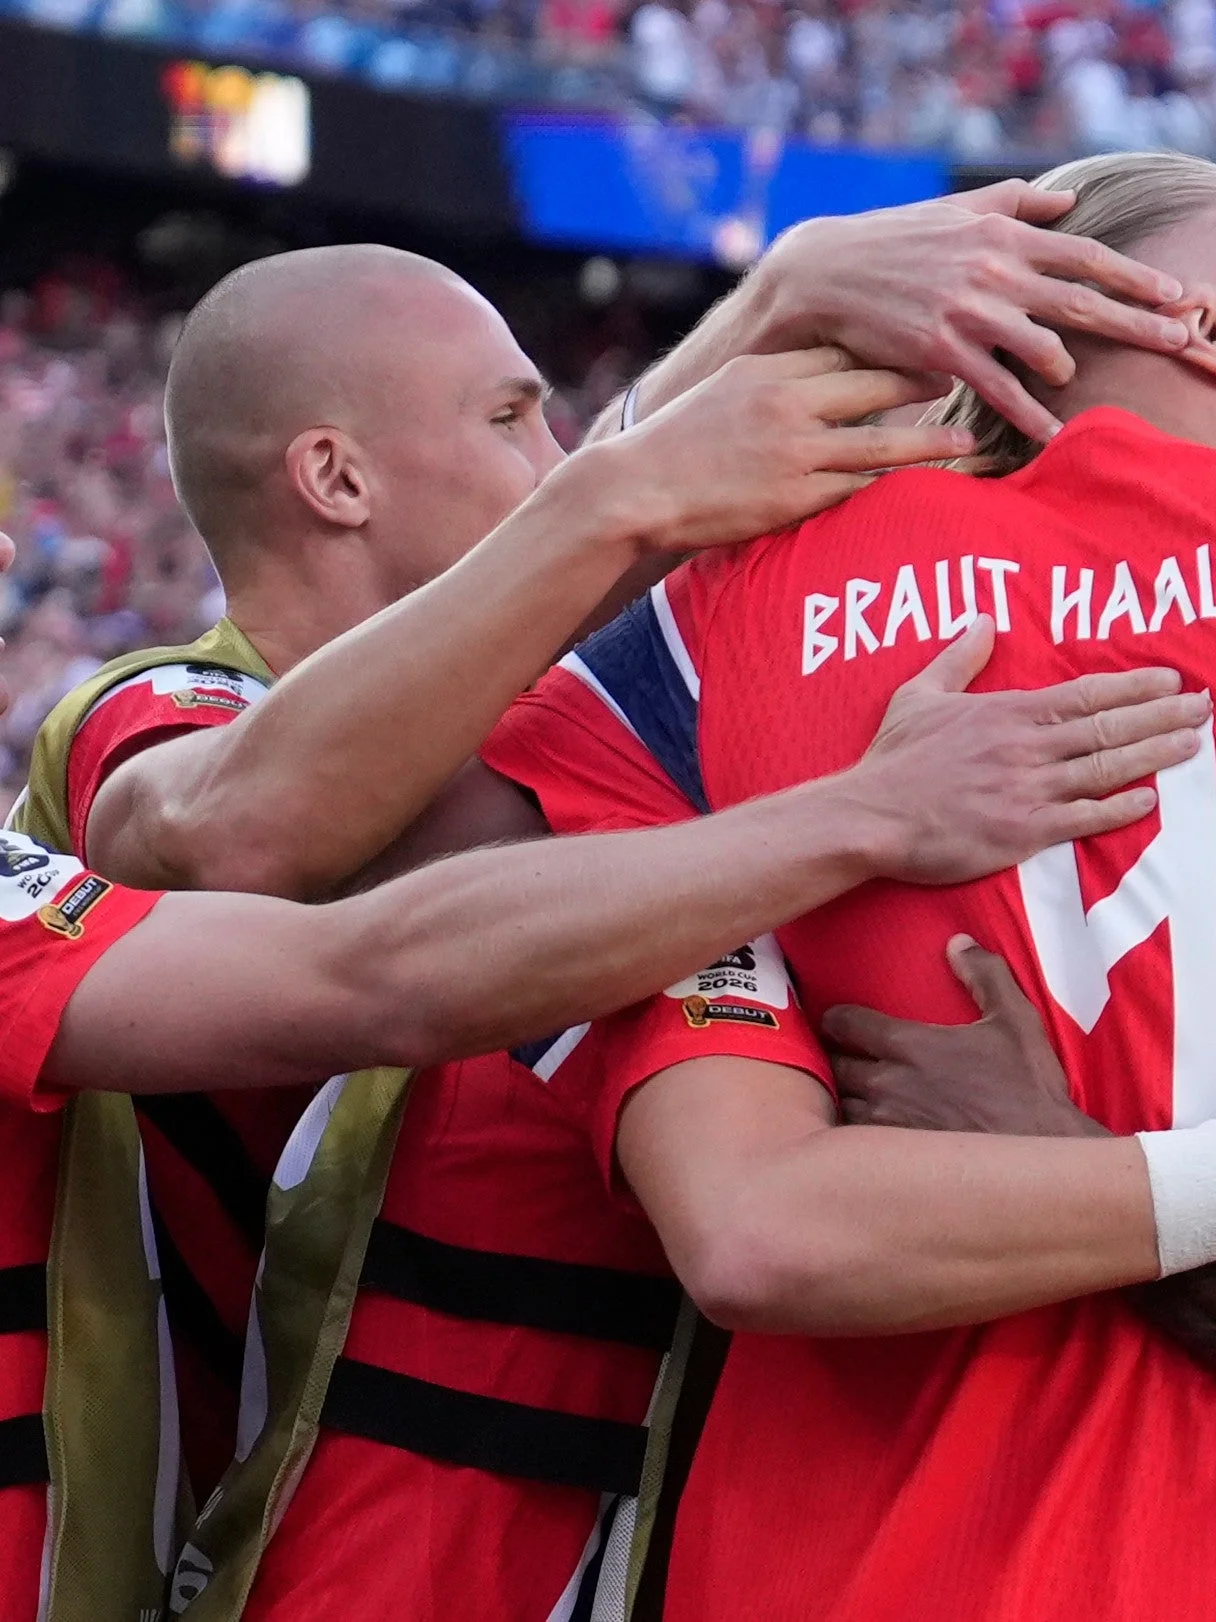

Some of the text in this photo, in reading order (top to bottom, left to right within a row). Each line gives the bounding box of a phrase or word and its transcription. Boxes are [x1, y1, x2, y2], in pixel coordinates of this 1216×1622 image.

[801, 554, 1020, 676] BRAUT
[61, 878, 98, 915] DEBUT
[697, 970, 758, 982] WORLD CUP
[698, 978, 758, 993] 2026
[708, 1005, 768, 1019] DEBUT
